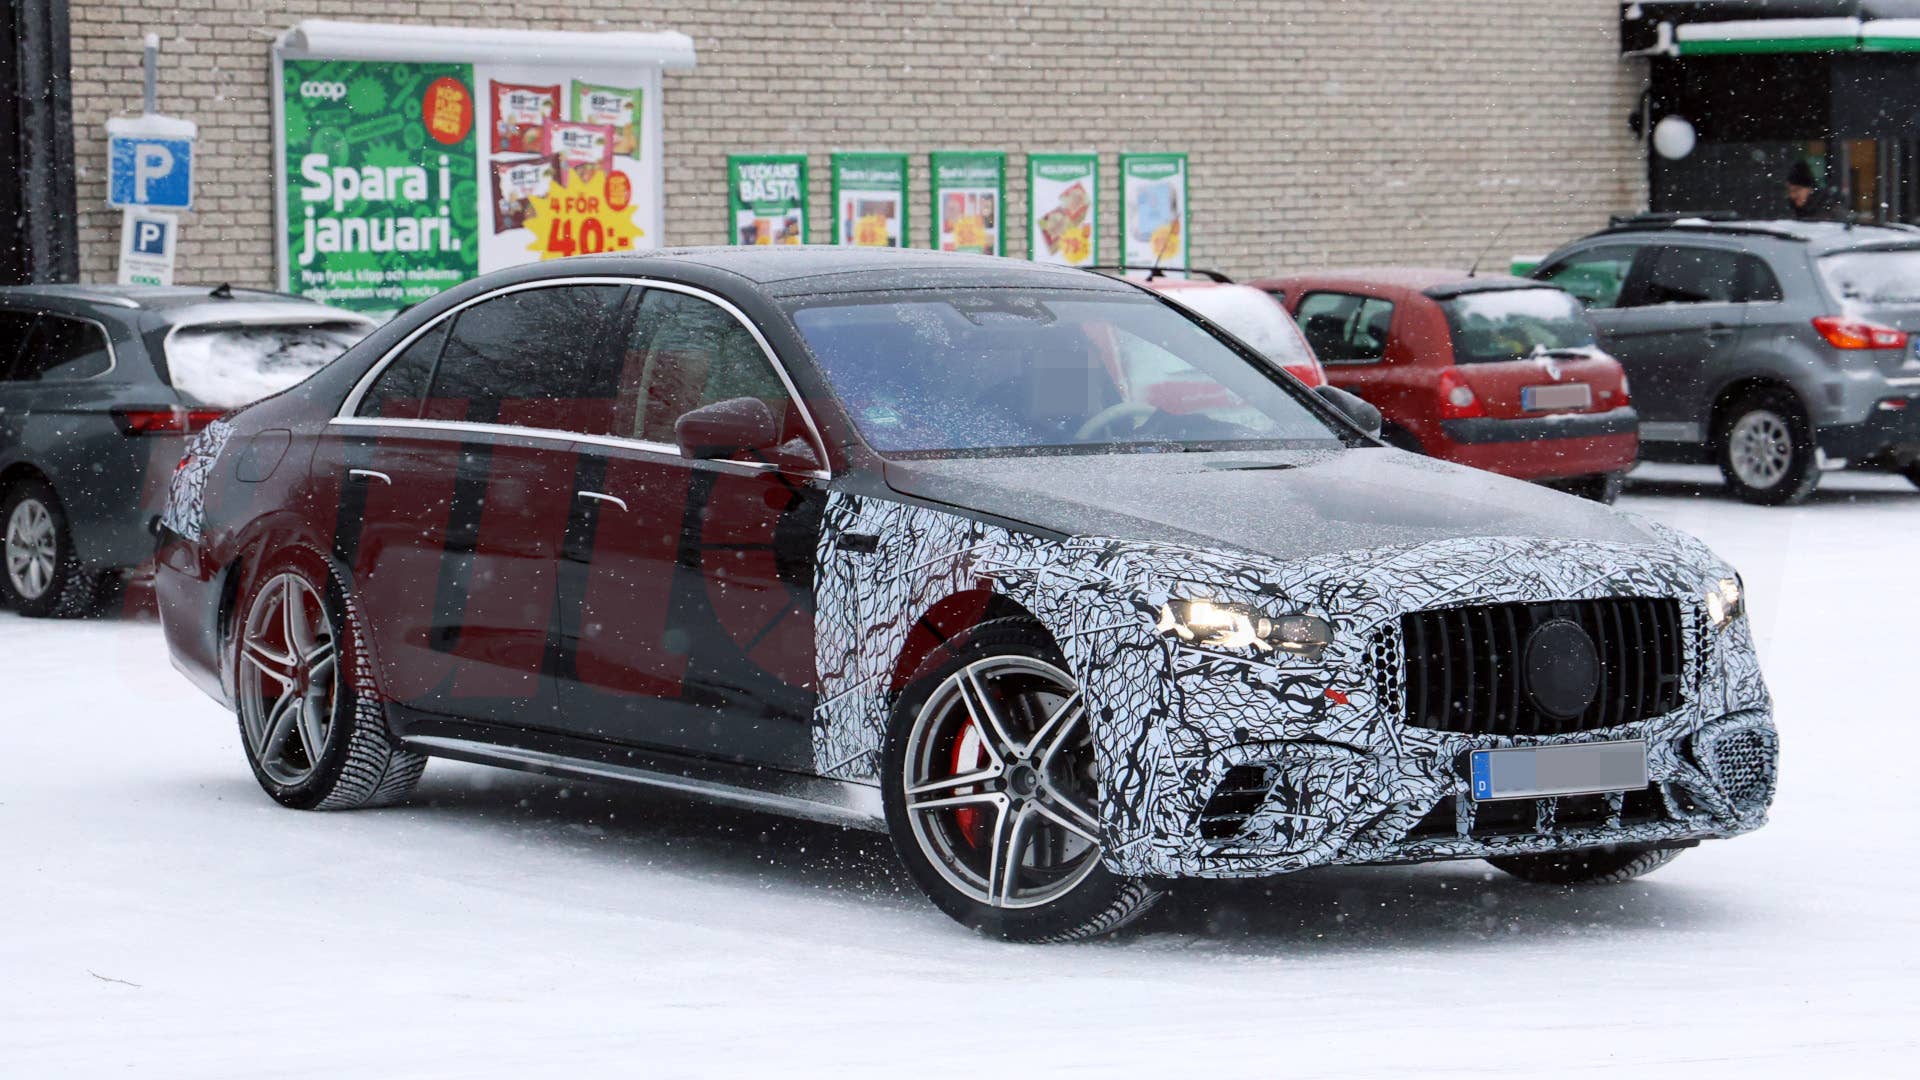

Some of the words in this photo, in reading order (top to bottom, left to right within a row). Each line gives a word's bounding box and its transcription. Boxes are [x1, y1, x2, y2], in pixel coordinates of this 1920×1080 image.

[300, 81, 347, 102] coop
[135, 144, 175, 202] P
[300, 153, 428, 213] Spara
[438, 154, 450, 201] i
[550, 197, 562, 214] 4
[565, 192, 600, 215] FÖR
[140, 223, 161, 252] P
[298, 205, 462, 266] januari.
[301, 270, 324, 285] Nya
[1478, 780, 1487, 791] D
